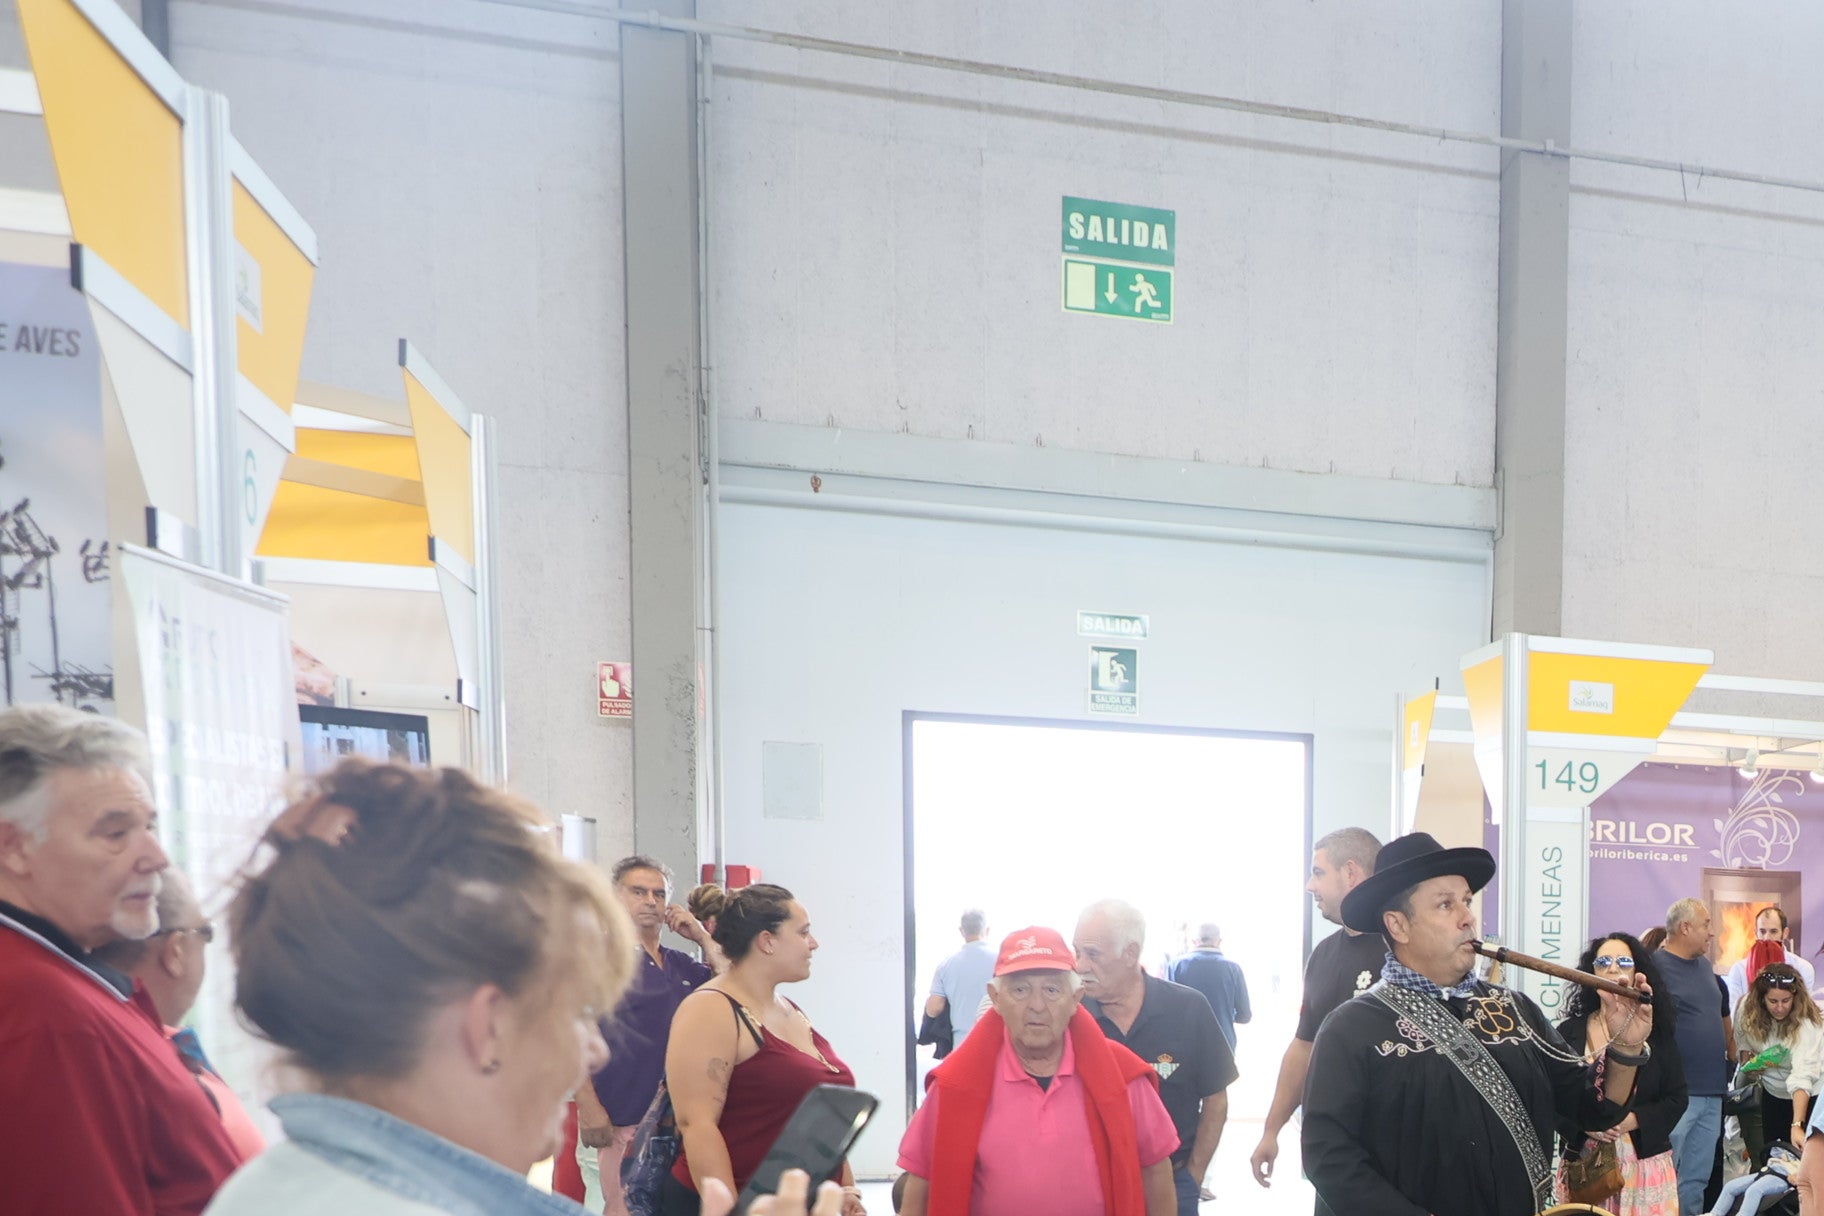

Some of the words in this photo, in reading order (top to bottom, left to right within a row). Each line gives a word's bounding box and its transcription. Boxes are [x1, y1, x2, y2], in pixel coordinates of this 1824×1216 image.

[1069, 211, 1168, 251] SALIDA
[15, 325, 81, 357] AVES
[1083, 616, 1143, 634] SALIDA
[1573, 697, 1609, 711] Salamaq
[1535, 759, 1599, 793] 149
[1540, 846, 1562, 1008] CHMENEAS
